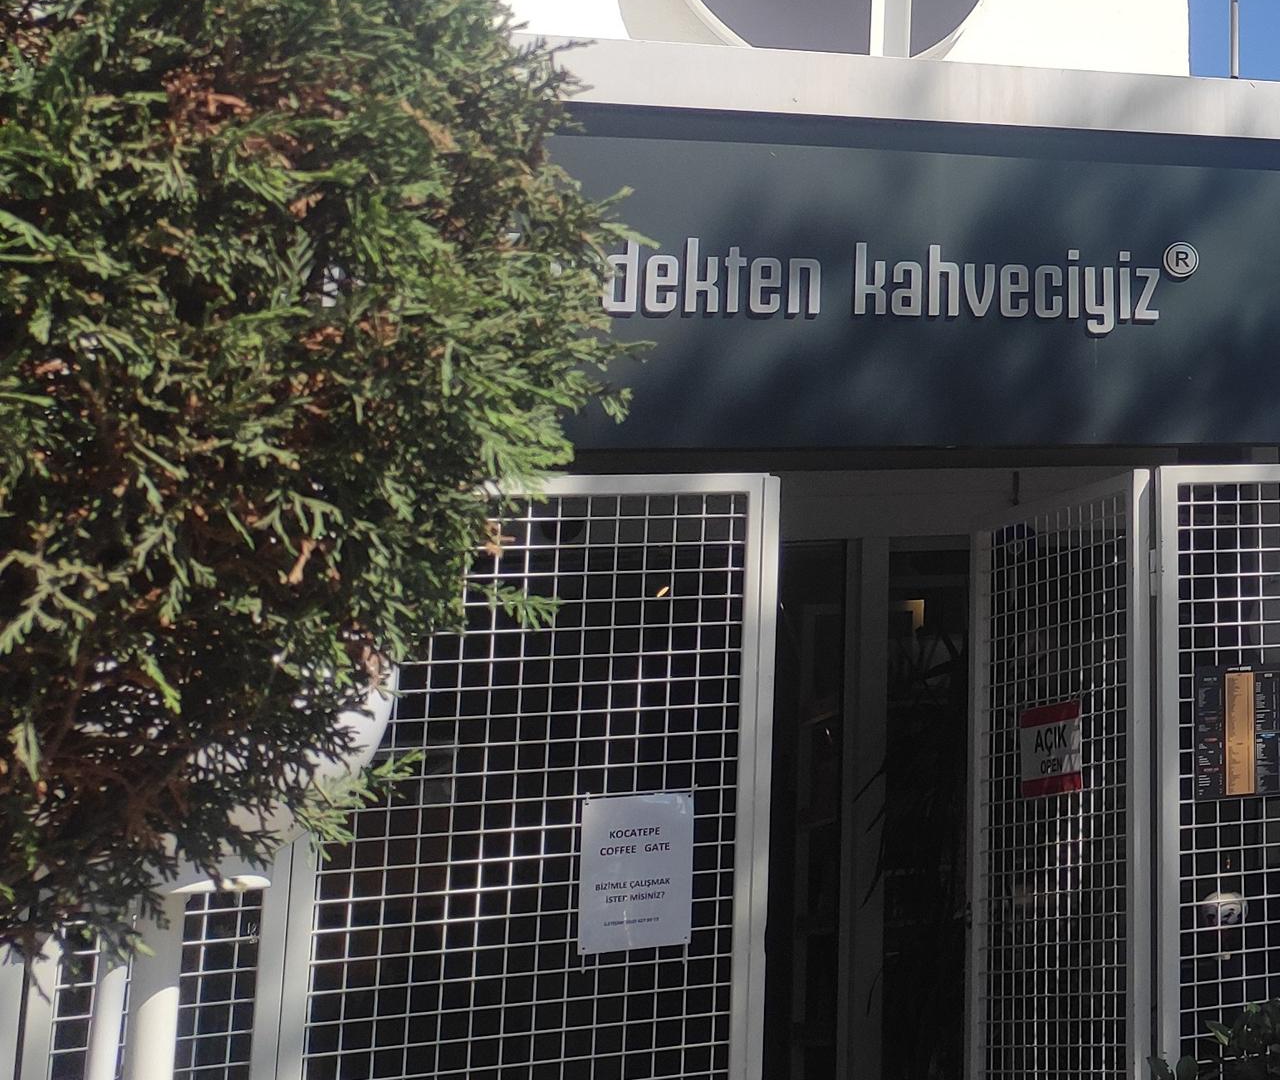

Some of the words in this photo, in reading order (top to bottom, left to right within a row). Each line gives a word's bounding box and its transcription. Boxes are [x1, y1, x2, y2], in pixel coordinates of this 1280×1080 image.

[601, 237, 822, 316] dekten
[1034, 724, 1067, 757] AÇIK
[609, 826, 661, 840] KOCATEPE
[599, 844, 637, 856] COFFEE
[644, 842, 671, 853] GATE
